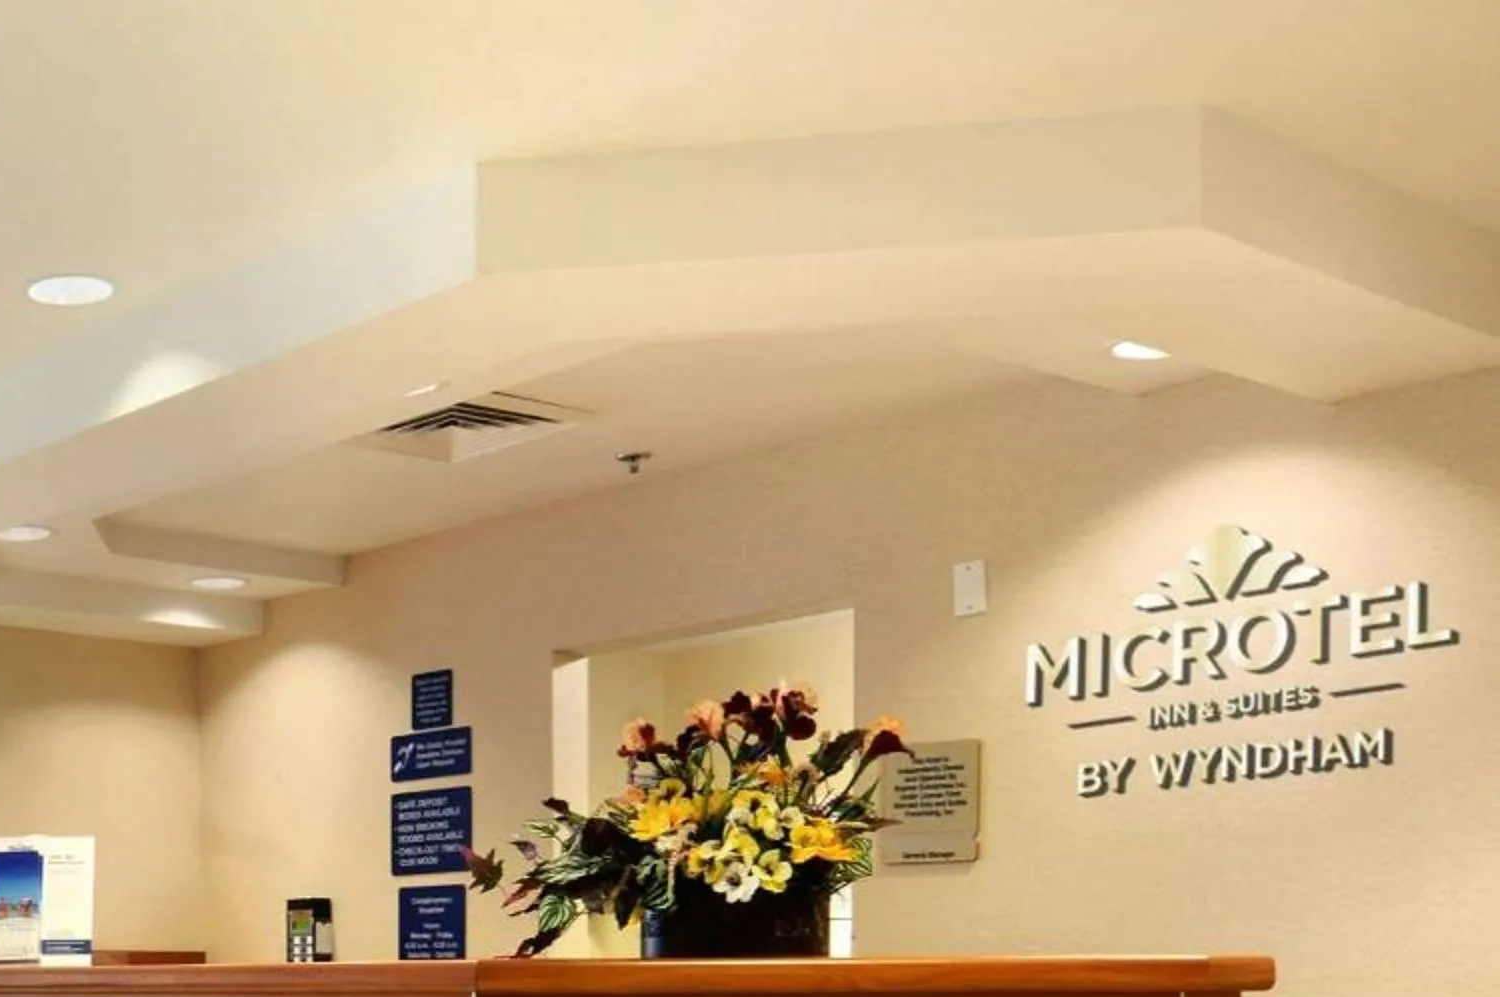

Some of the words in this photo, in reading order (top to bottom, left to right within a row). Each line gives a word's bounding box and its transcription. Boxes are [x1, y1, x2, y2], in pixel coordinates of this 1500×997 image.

[1024, 581, 1459, 708] MICROTEL
[1149, 702, 1197, 731] INN
[1201, 700, 1221, 723] &
[1226, 686, 1321, 719] SUITES
[1077, 757, 1136, 797] BY
[1148, 728, 1394, 790] WYNDHAM
